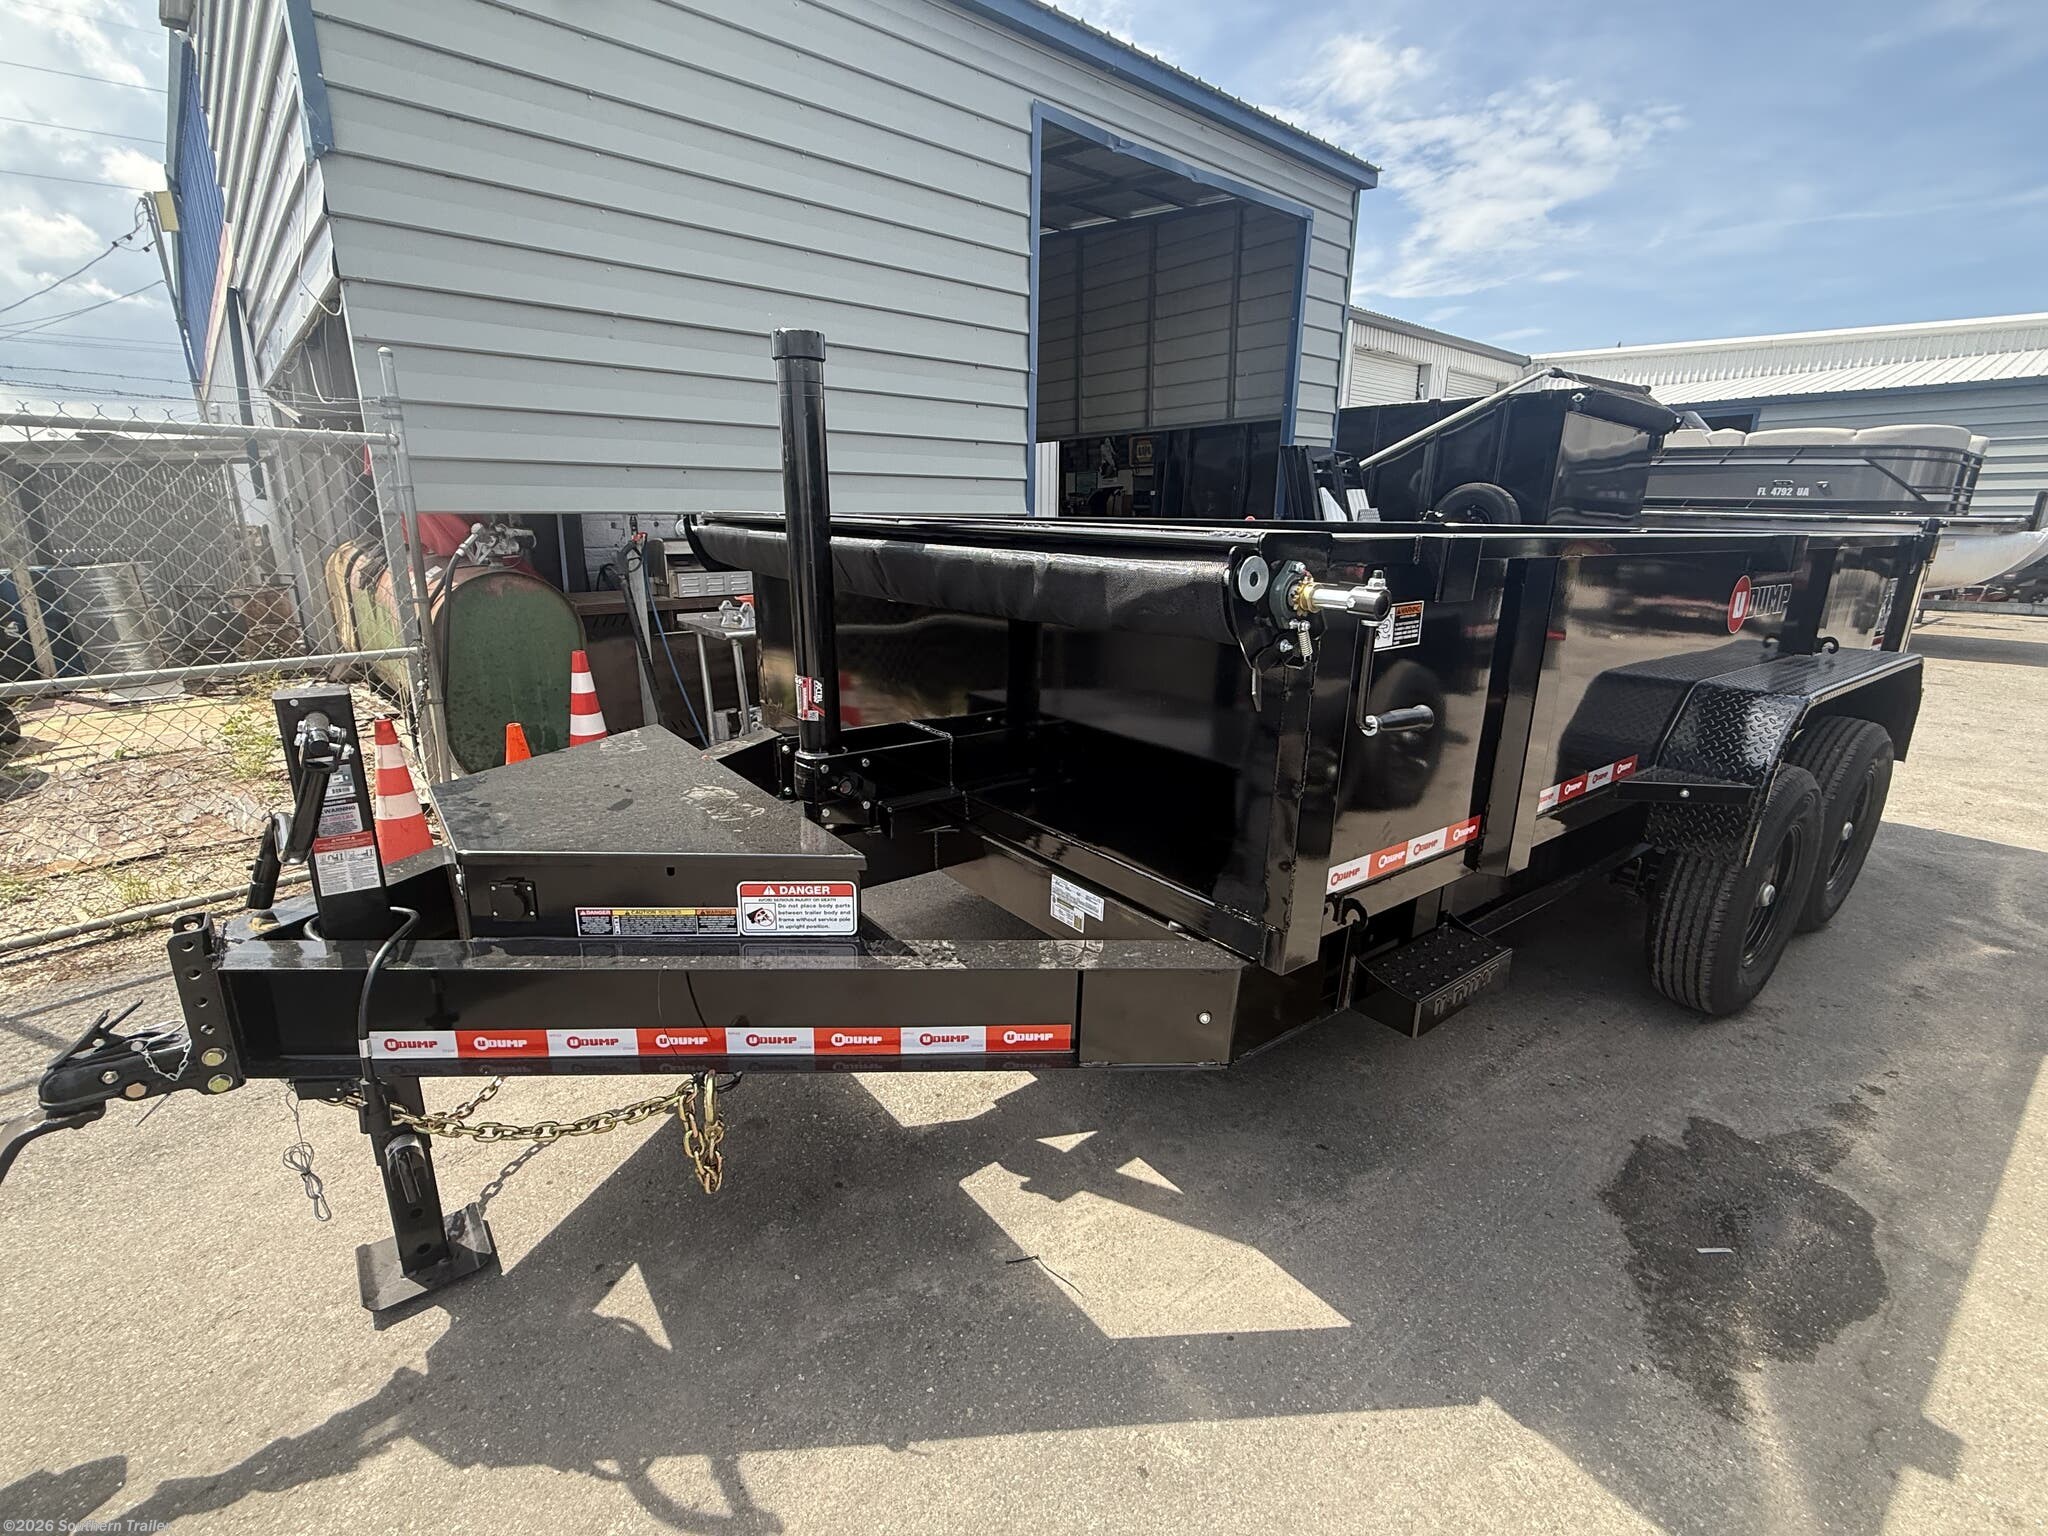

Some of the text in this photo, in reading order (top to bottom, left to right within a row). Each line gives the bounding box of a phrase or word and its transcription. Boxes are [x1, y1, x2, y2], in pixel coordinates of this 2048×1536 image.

[1757, 487, 1809, 496] FL 4792 UA
[779, 886, 830, 895] DANGER
